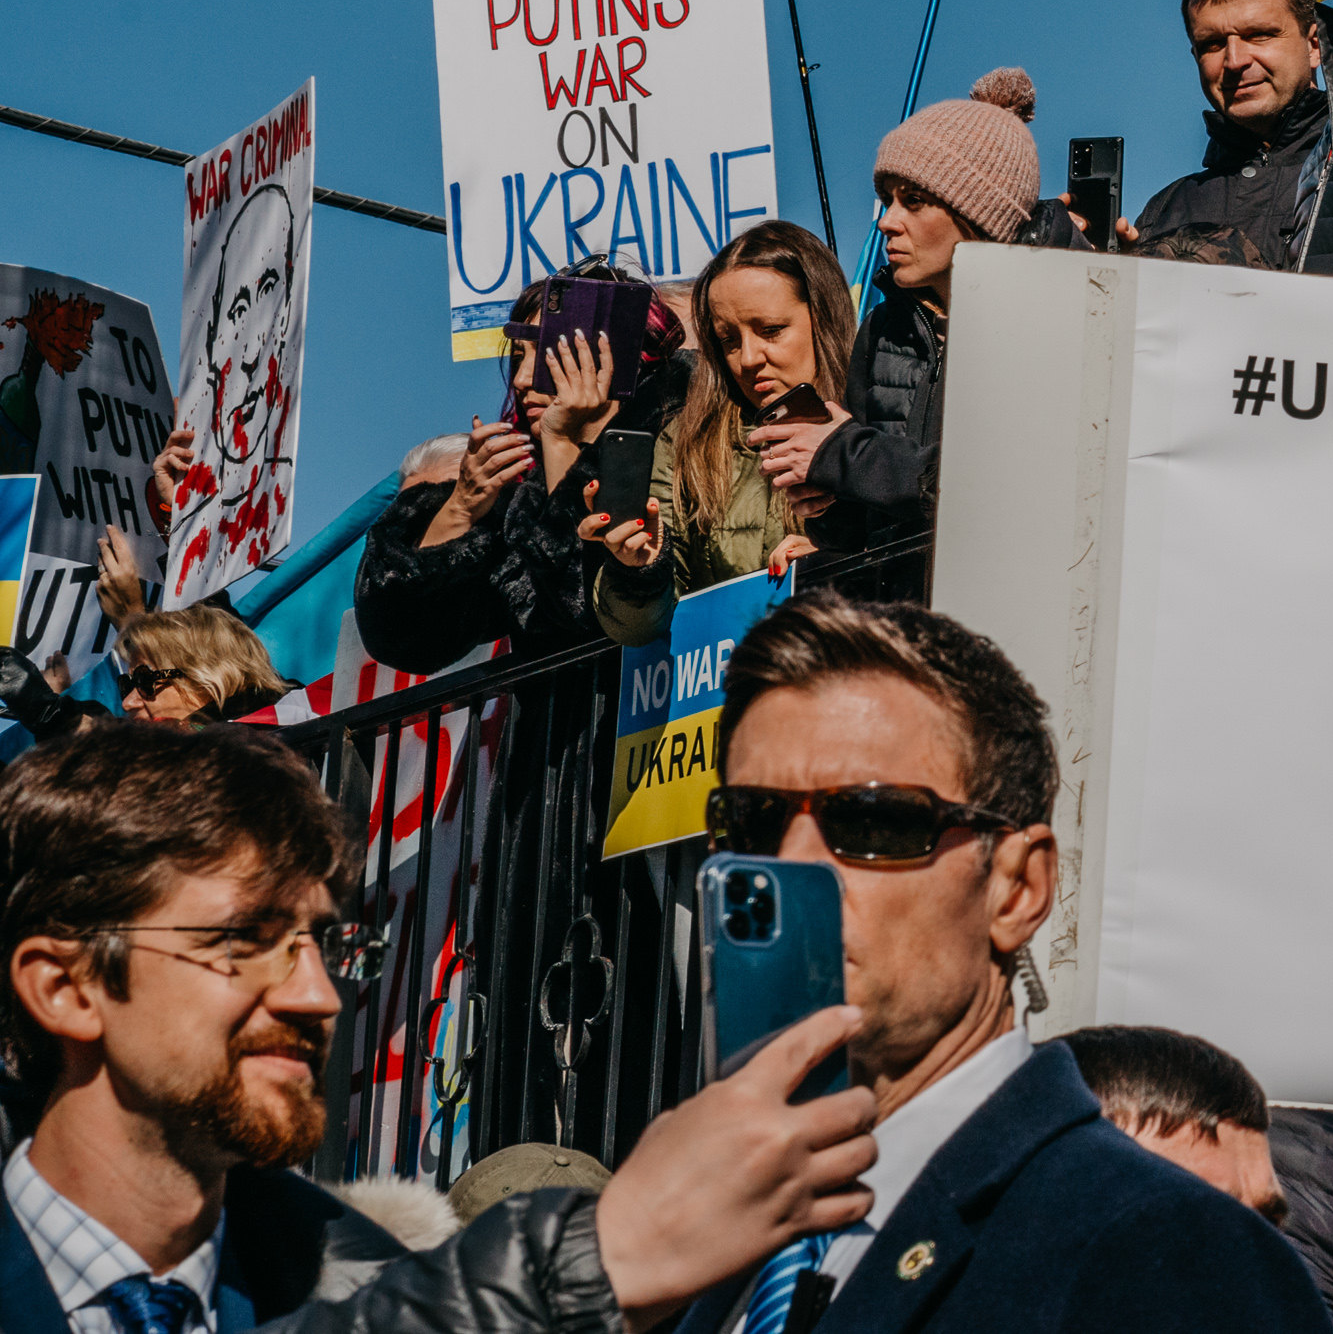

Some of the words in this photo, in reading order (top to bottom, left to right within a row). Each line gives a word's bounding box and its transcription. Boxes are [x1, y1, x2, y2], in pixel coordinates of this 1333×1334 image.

[538, 36, 652, 110] WAR
[187, 149, 232, 225] WAR
[240, 91, 311, 197] CRIMINAL
[557, 102, 639, 169] ON
[450, 144, 770, 295] UKRAINE
[109, 326, 157, 395] TO
[78, 387, 174, 464] PUTIN
[47, 461, 141, 536] WITH
[631, 660, 670, 716] NO
[677, 638, 736, 702] WAR
